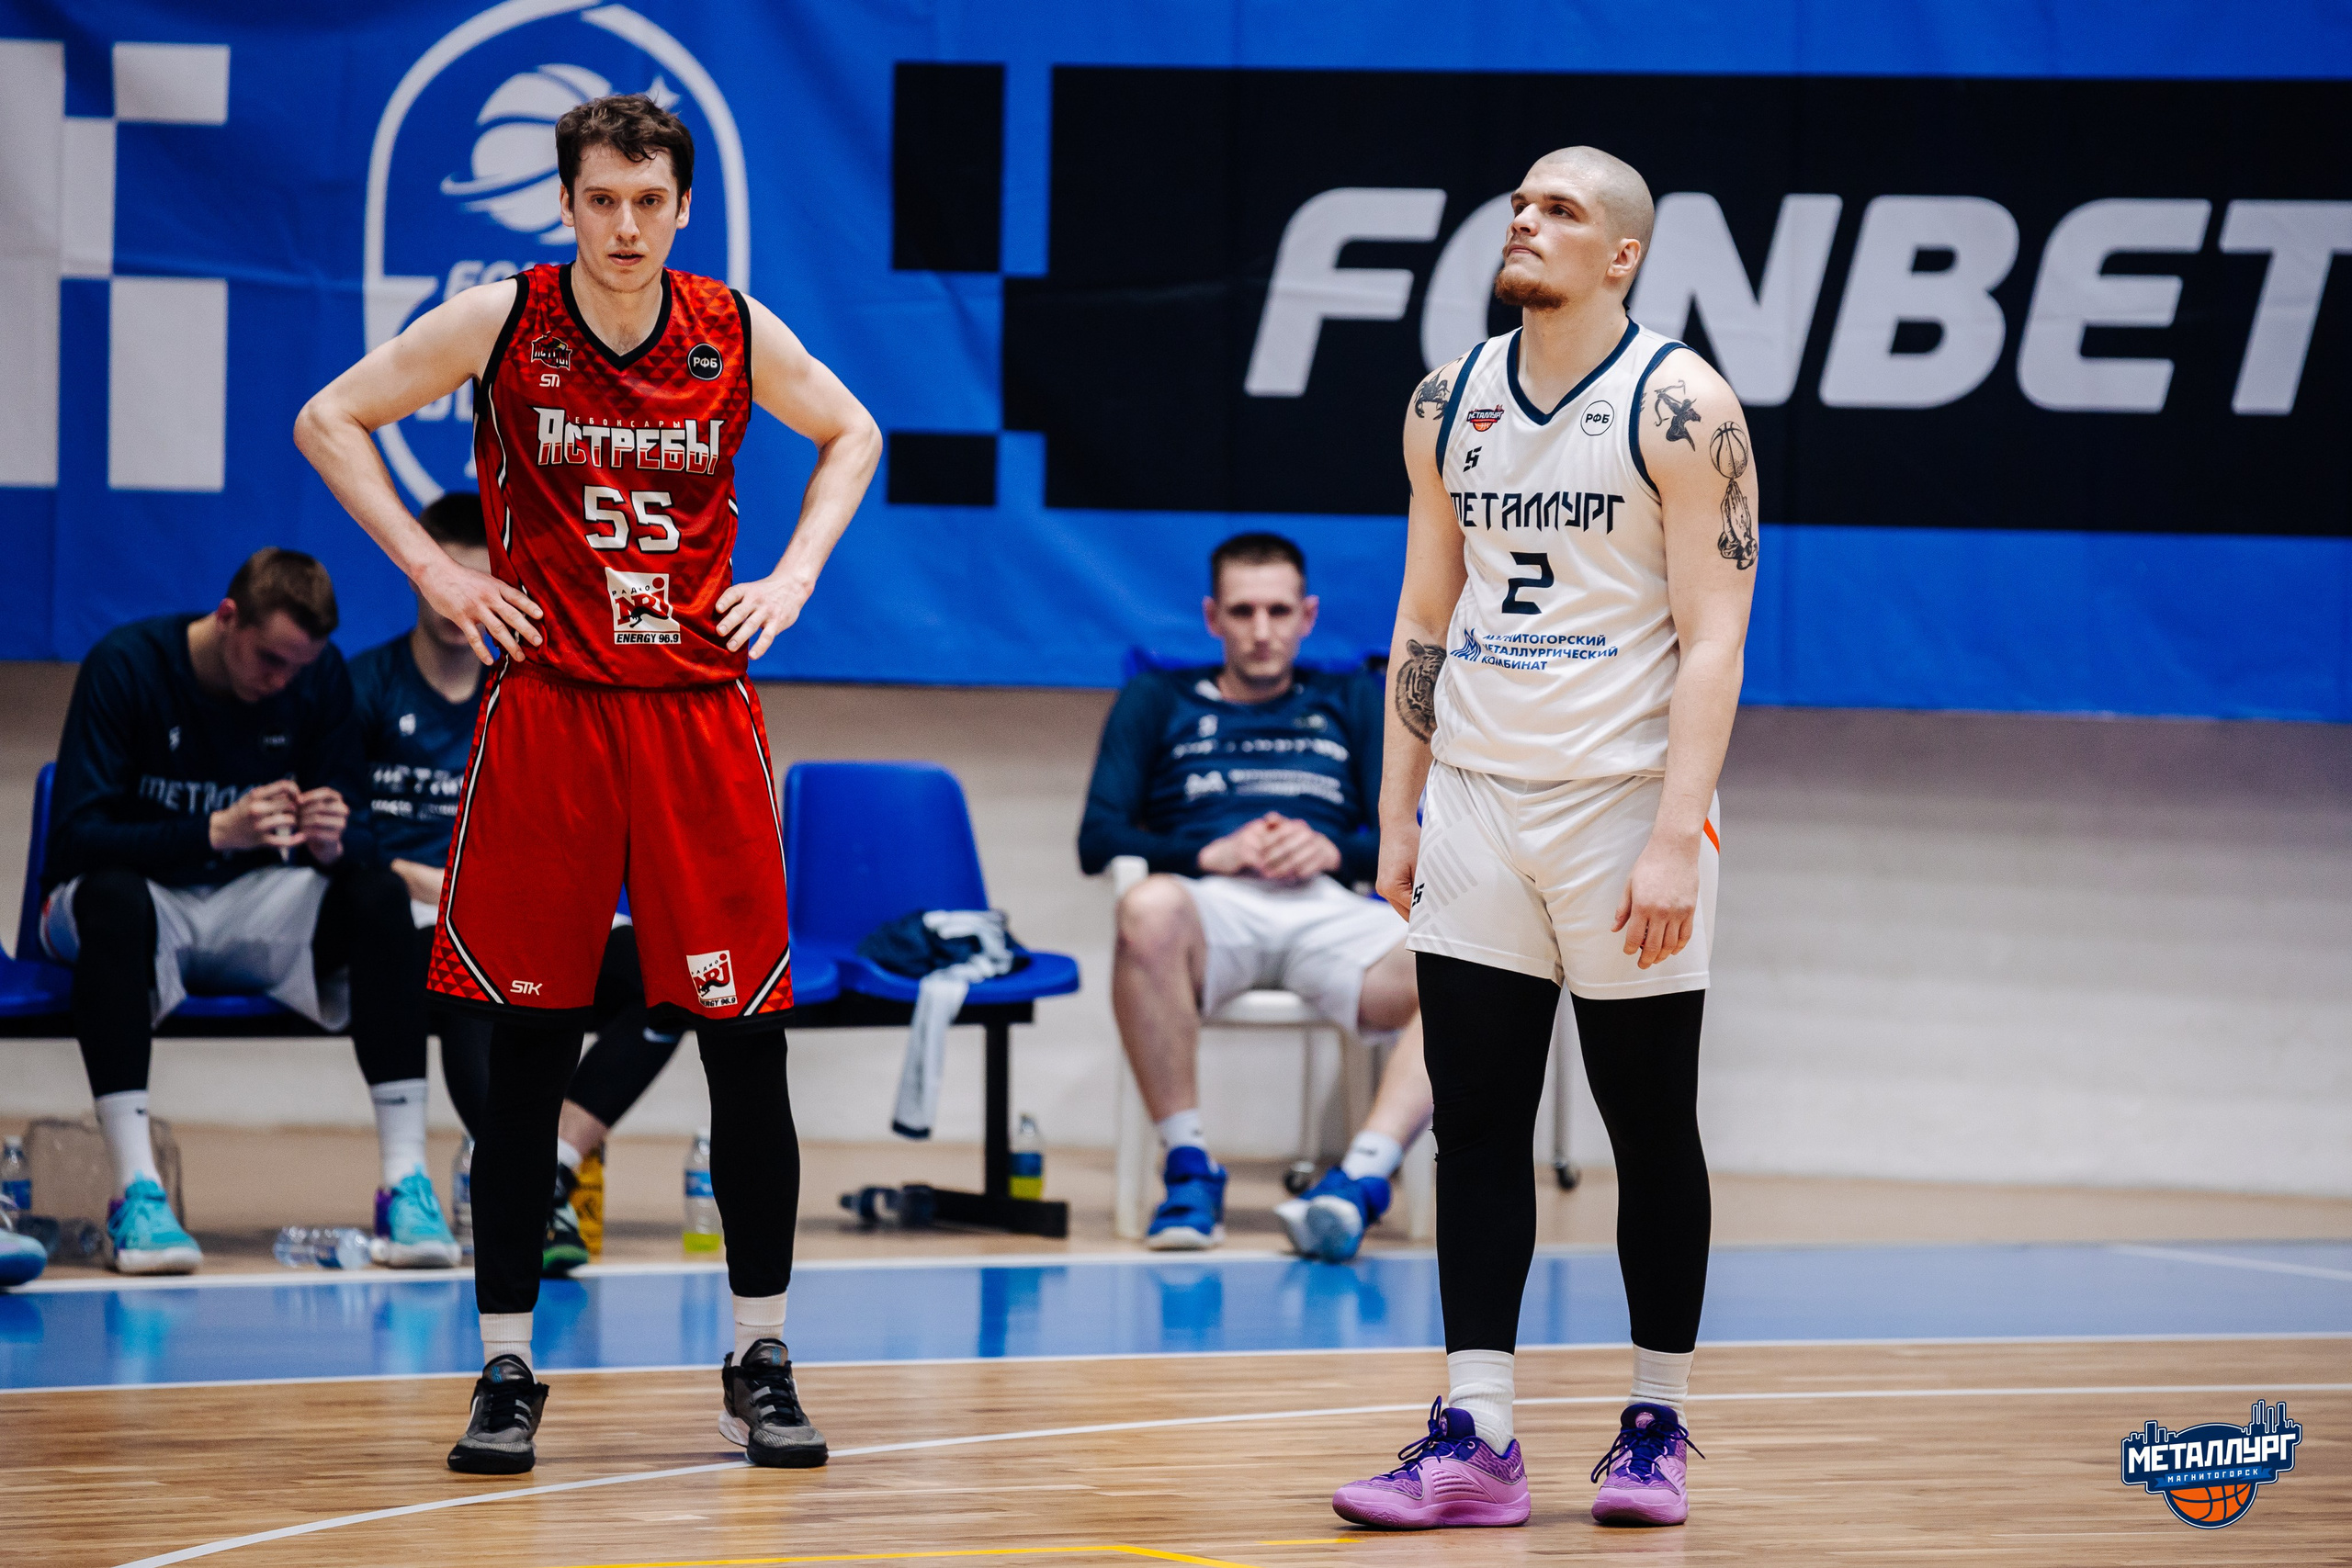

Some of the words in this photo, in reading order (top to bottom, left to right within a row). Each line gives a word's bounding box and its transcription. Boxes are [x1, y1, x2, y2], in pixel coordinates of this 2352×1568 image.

[693, 356, 718, 368] РФБ
[568, 416, 681, 429] ЕБОКСАРЫ
[1585, 413, 1610, 423] РФБ
[532, 407, 725, 475] ЯСТРЕБЫ
[583, 485, 681, 552] 55
[1502, 551, 1555, 615] 2
[612, 585, 650, 596] РАДО
[616, 634, 657, 643] ENERGY
[659, 634, 680, 643] 96.9
[1481, 655, 1547, 671] КОМБИНАТ
[510, 979, 543, 996] STK
